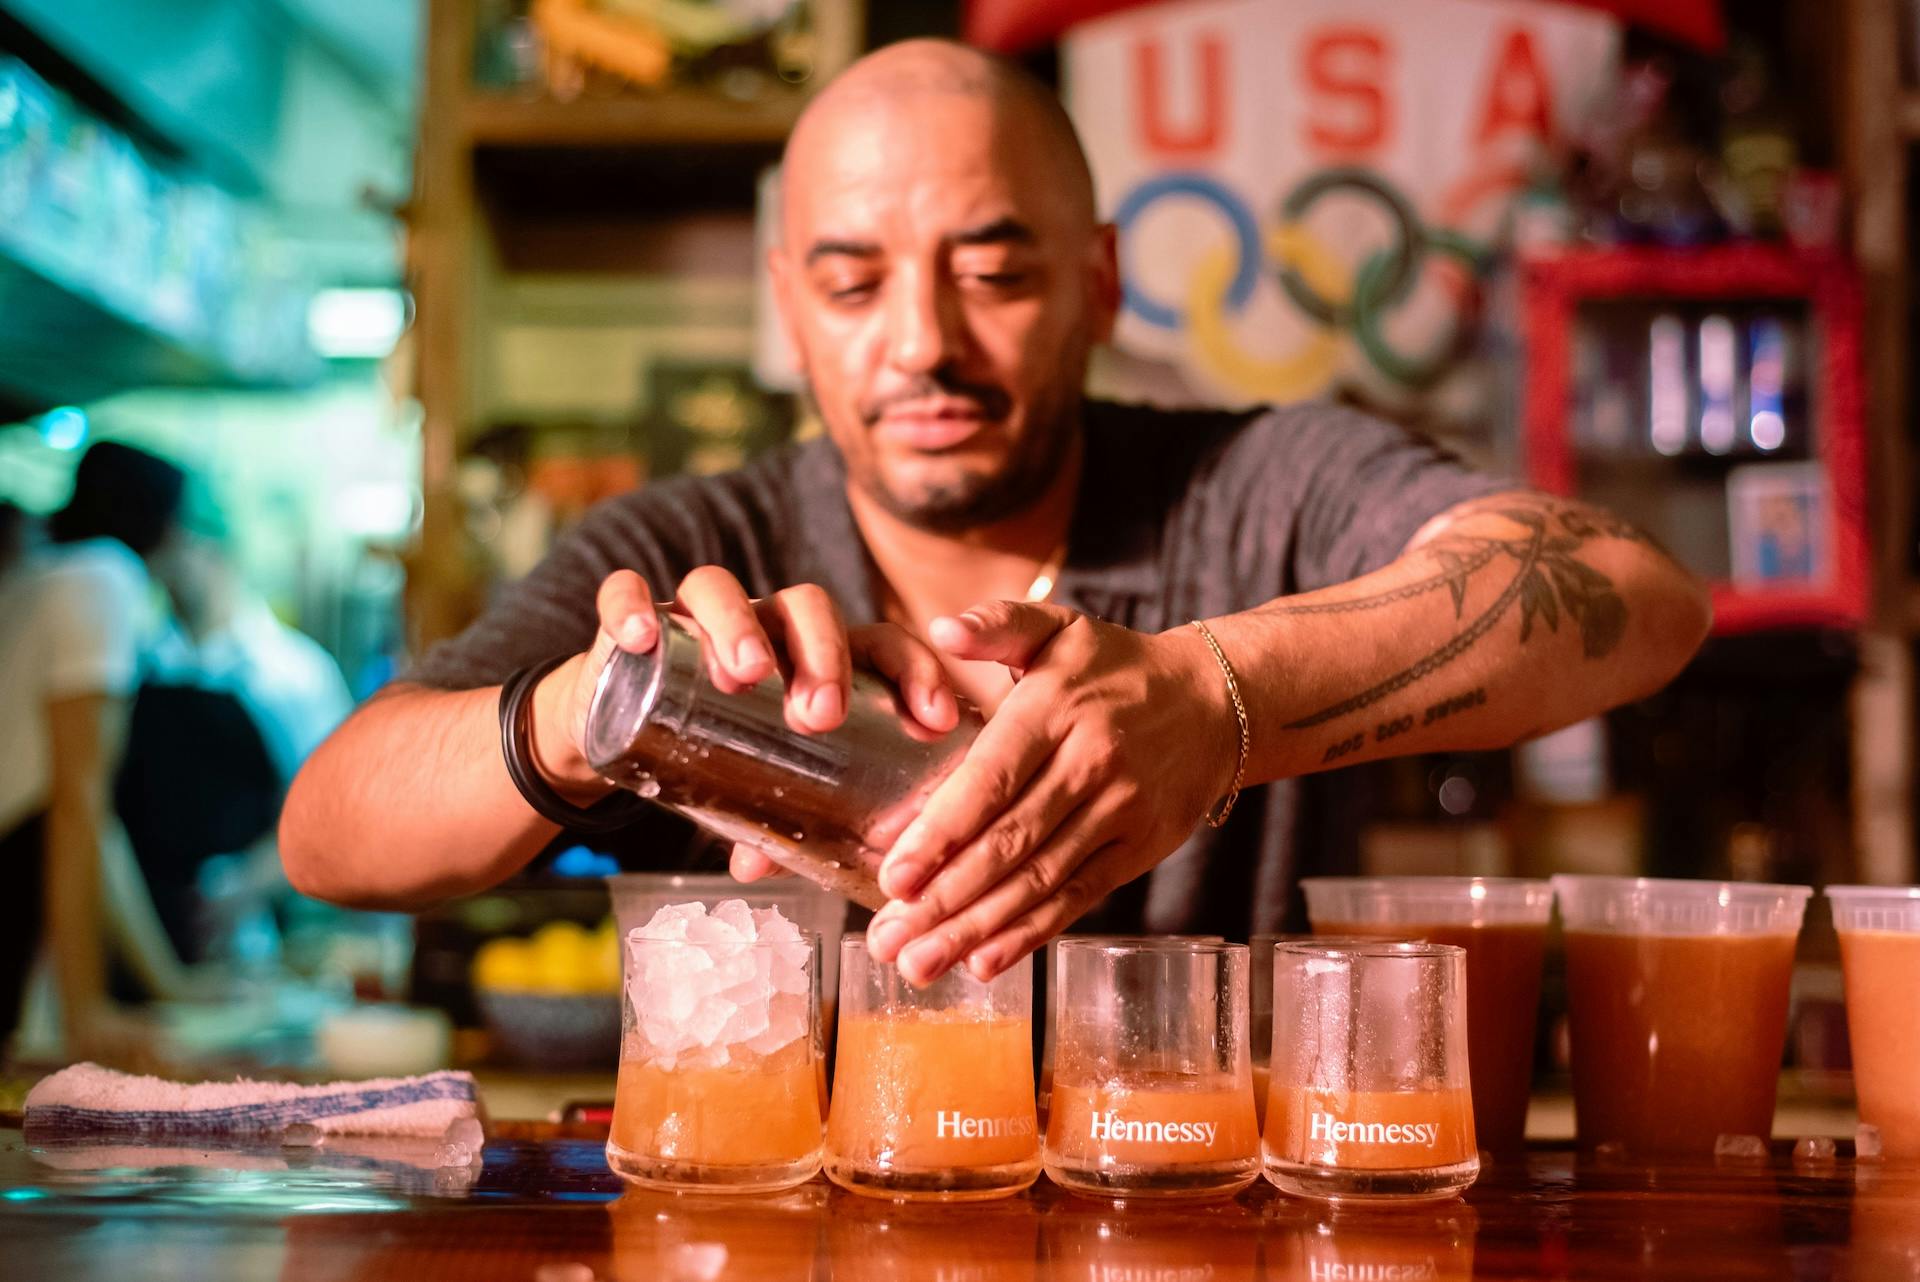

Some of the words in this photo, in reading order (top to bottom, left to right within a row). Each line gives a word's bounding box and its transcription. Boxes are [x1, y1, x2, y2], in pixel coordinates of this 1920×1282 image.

[1128, 26, 1556, 157] USA
[936, 1110, 1034, 1138] Henness
[1090, 1111, 1218, 1147] Hennessy
[1310, 1112, 1440, 1148] Hennessy
